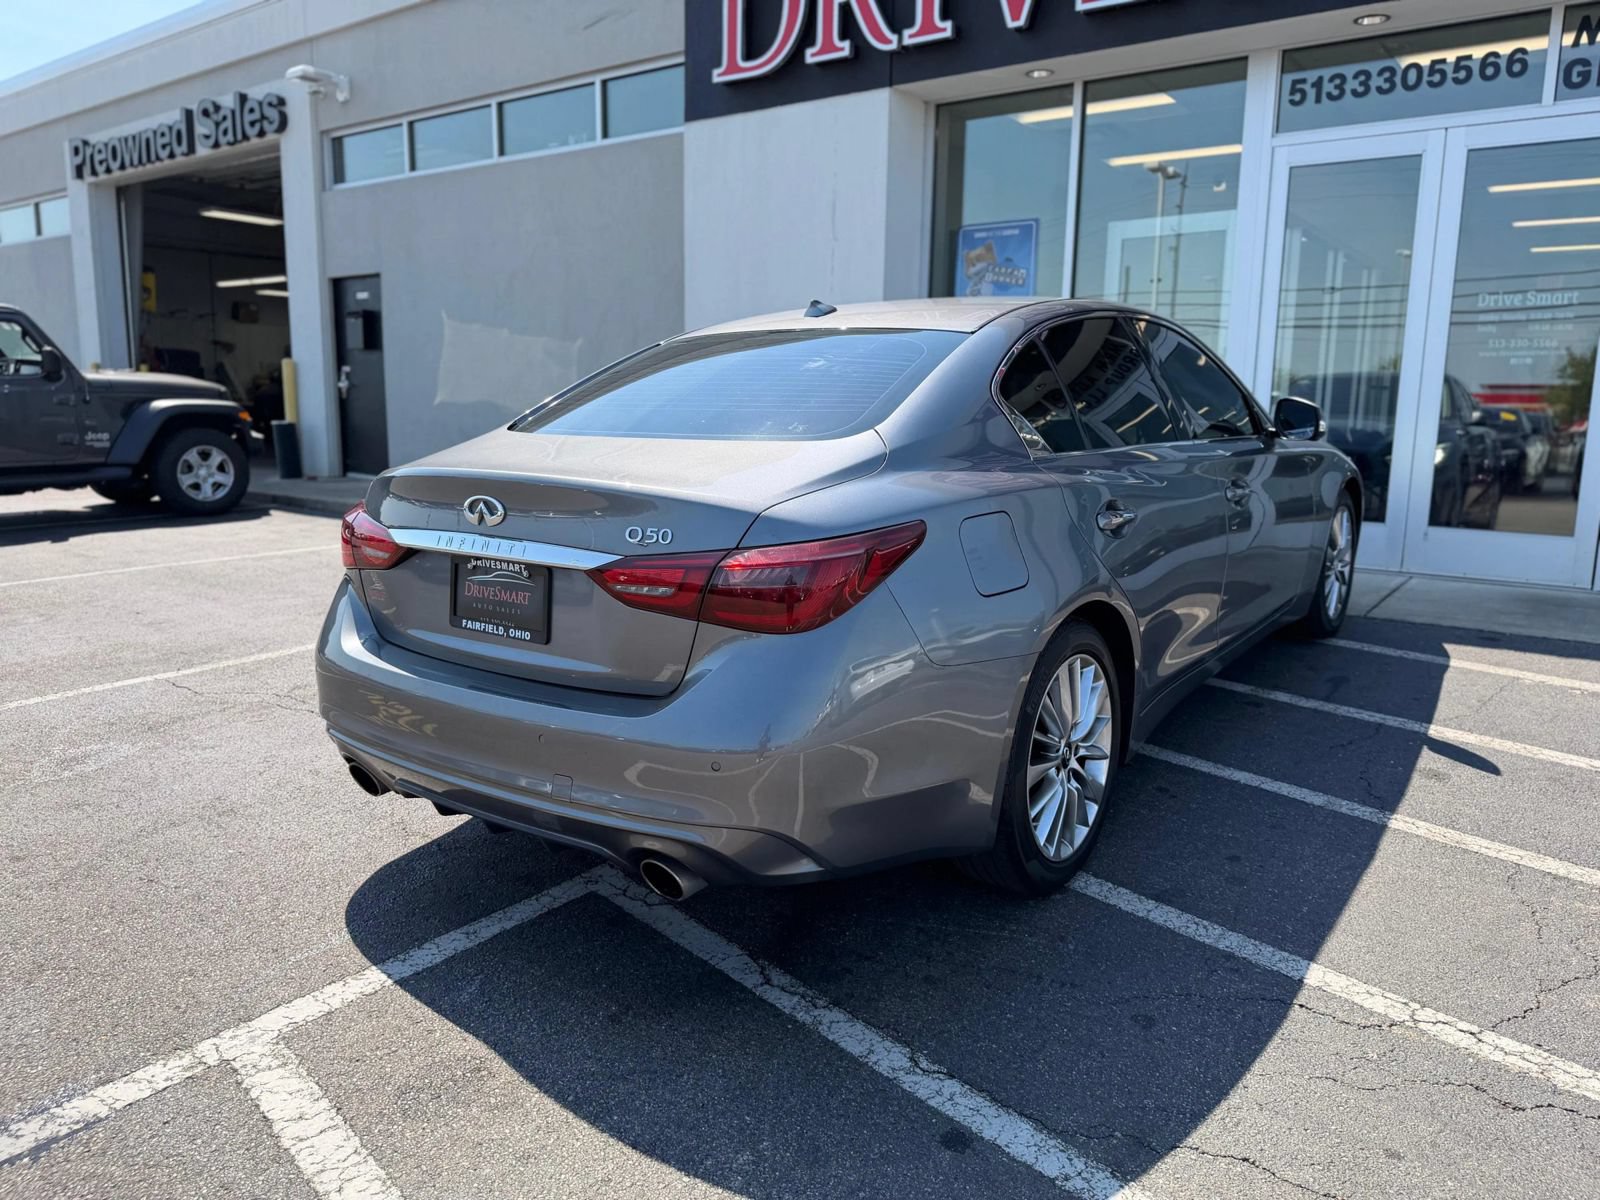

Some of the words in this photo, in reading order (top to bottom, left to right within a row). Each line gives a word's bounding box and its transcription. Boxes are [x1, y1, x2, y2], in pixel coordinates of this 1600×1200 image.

[1288, 47, 1529, 106] 5133305566
[69, 107, 195, 180] Preowned
[197, 91, 288, 149] Sales
[1478, 289, 1522, 307] Drive
[1525, 289, 1579, 306] Smart
[436, 534, 527, 557] INFINITI
[625, 526, 673, 546] Q50
[462, 619, 507, 638] FAIRFIELD,
[509, 629, 530, 641] OHIO
